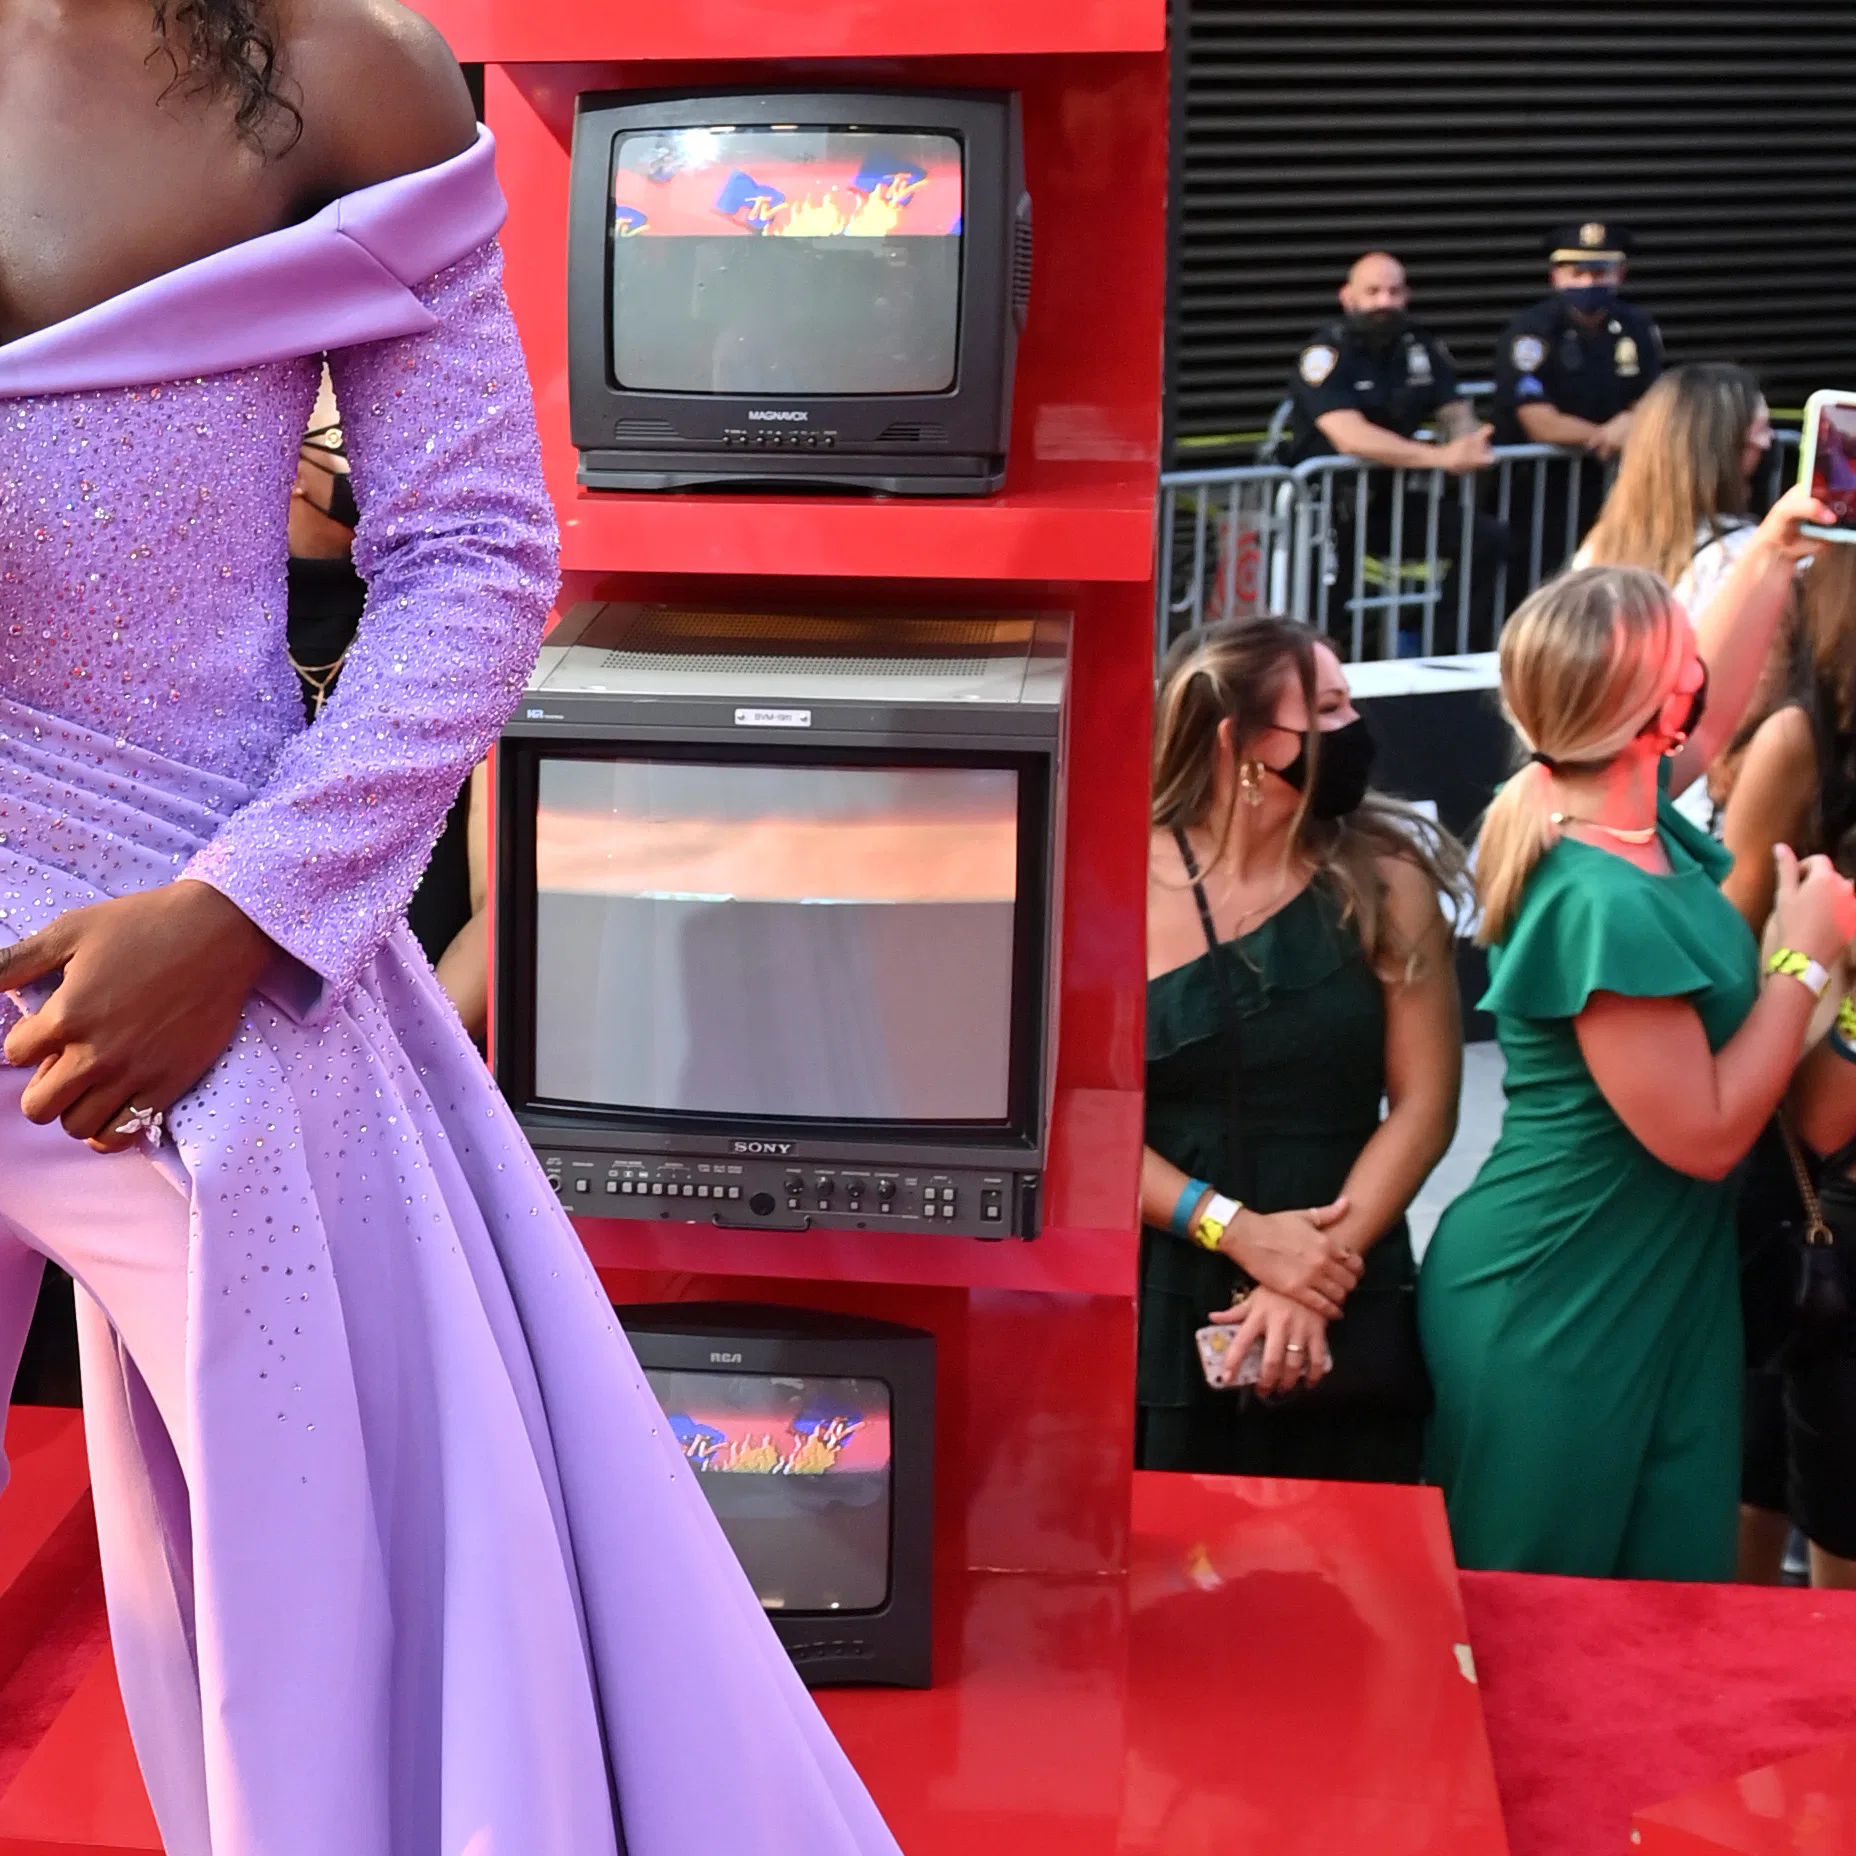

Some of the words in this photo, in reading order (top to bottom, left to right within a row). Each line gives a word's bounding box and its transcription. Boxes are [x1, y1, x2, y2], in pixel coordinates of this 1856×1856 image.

[747, 410, 809, 422] MAGNAVOX
[733, 1140, 792, 1154] SONY
[710, 1352, 742, 1363] RCA
